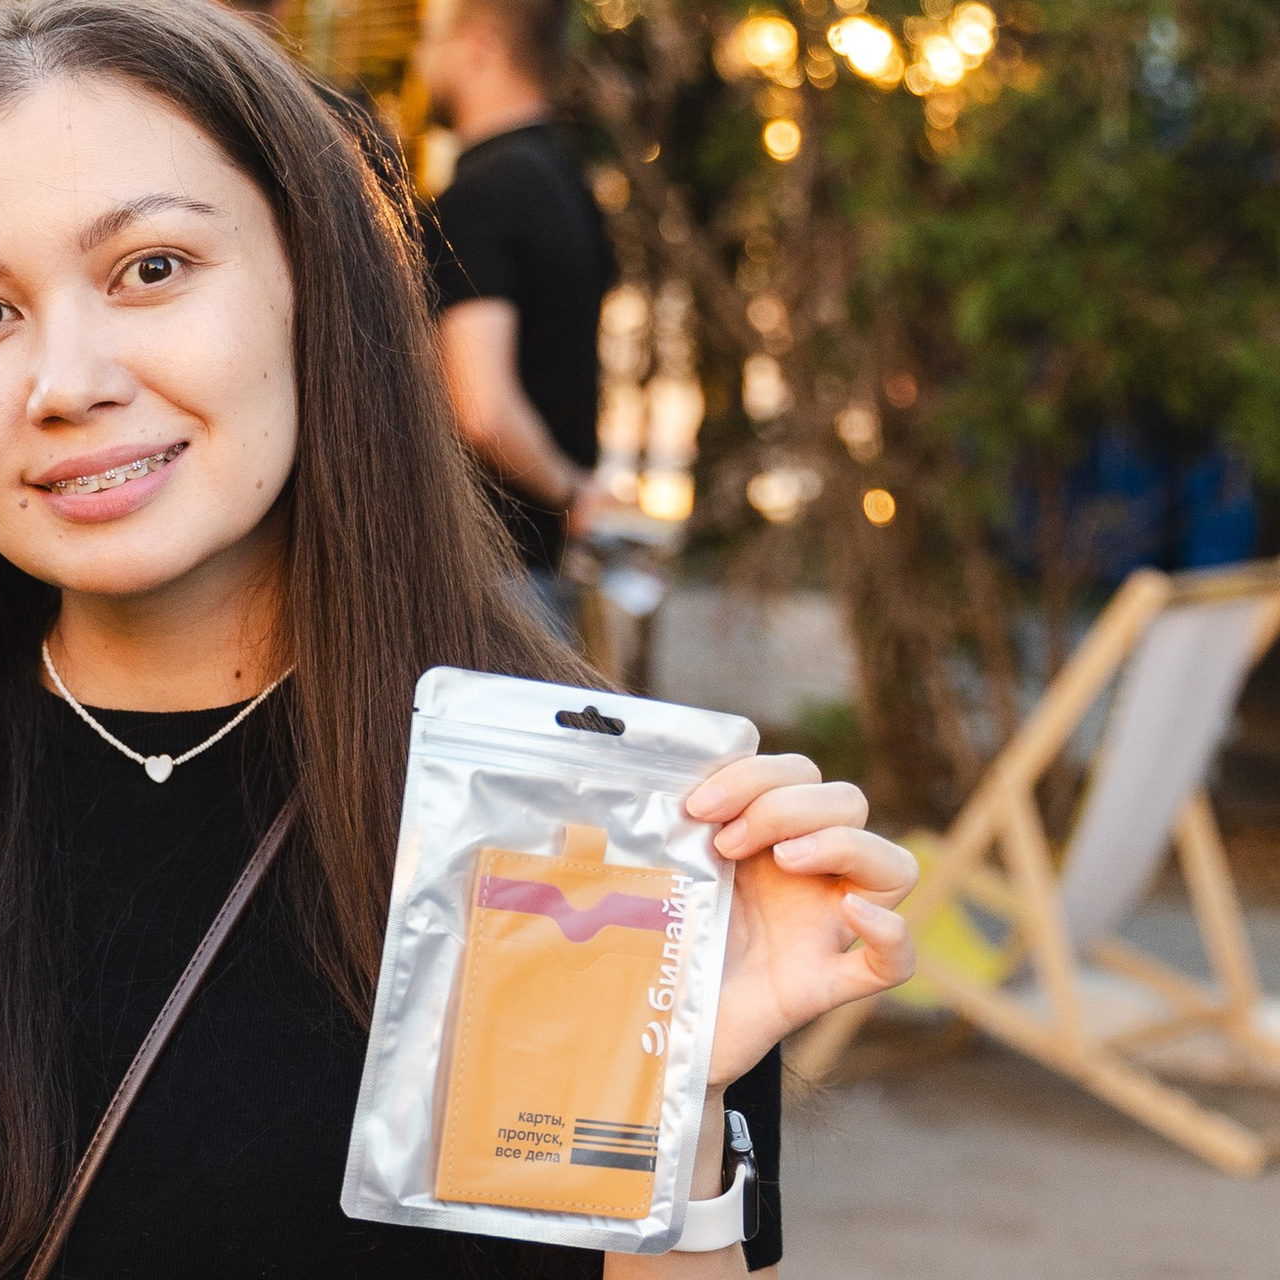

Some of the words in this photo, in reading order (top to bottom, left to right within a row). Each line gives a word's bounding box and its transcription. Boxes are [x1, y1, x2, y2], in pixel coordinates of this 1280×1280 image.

[648, 874, 694, 1012] билайн
[518, 1111, 566, 1129] карты,
[497, 1128, 564, 1147] пропуск,
[495, 1146, 522, 1159] все
[524, 1150, 561, 1163] дела
